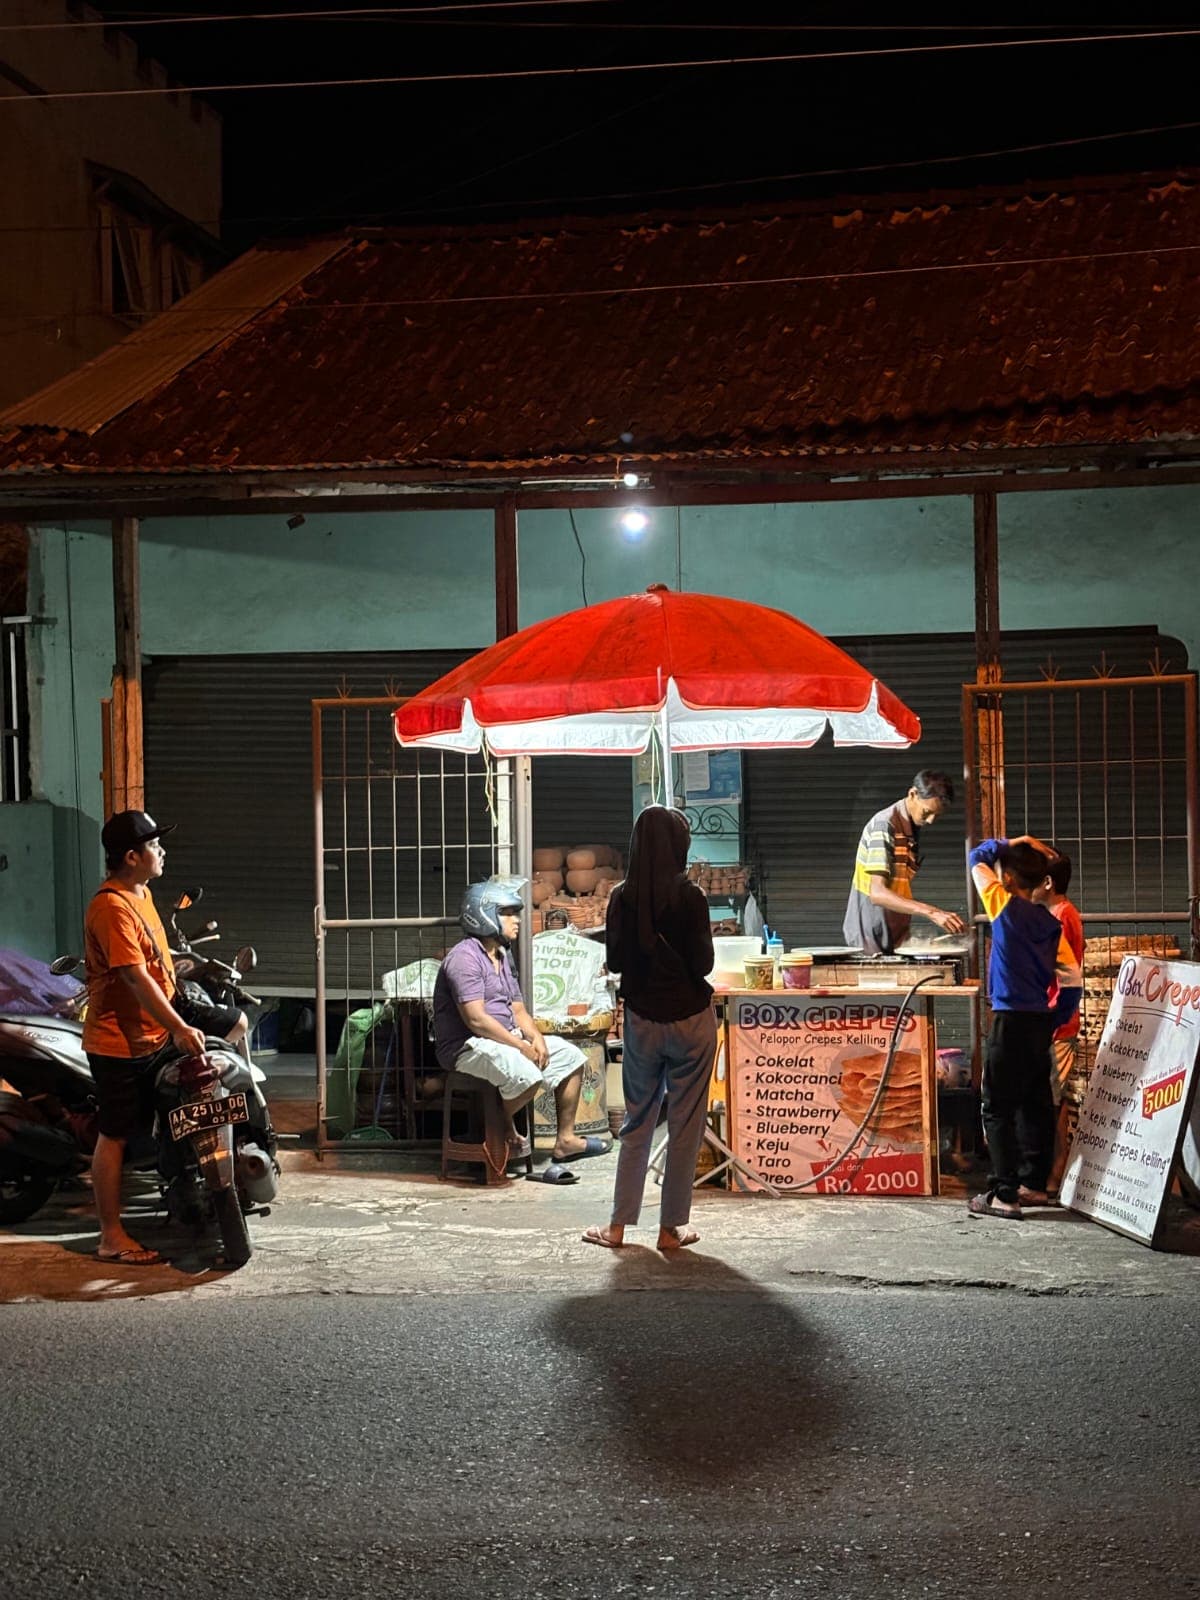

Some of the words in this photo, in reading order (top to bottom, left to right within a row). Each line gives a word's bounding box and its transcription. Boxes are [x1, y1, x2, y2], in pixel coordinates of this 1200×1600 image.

[1118, 958, 1145, 998] Box
[1145, 965, 1200, 1027] Crepe
[739, 1003, 800, 1030] BOX
[804, 1004, 917, 1032] CREPES
[760, 1033, 800, 1048] Pelopor
[804, 1034, 842, 1048] Crepes
[847, 1033, 886, 1048] Keliling
[755, 1055, 815, 1068] Cokelat
[755, 1072, 843, 1085] Kokocranci
[1102, 1064, 1138, 1087] Blueberry
[756, 1089, 814, 1101] Matcha
[1096, 1087, 1138, 1112] Strawberry
[1144, 1078, 1183, 1115] 5000
[172, 1109, 187, 1125] AA
[756, 1105, 841, 1122] Strawberry
[756, 1121, 830, 1138] Blueberry
[756, 1138, 789, 1155] Keju
[1110, 1142, 1139, 1162] crepes
[757, 1155, 791, 1168] Taro
[864, 1170, 918, 1192] 2000
